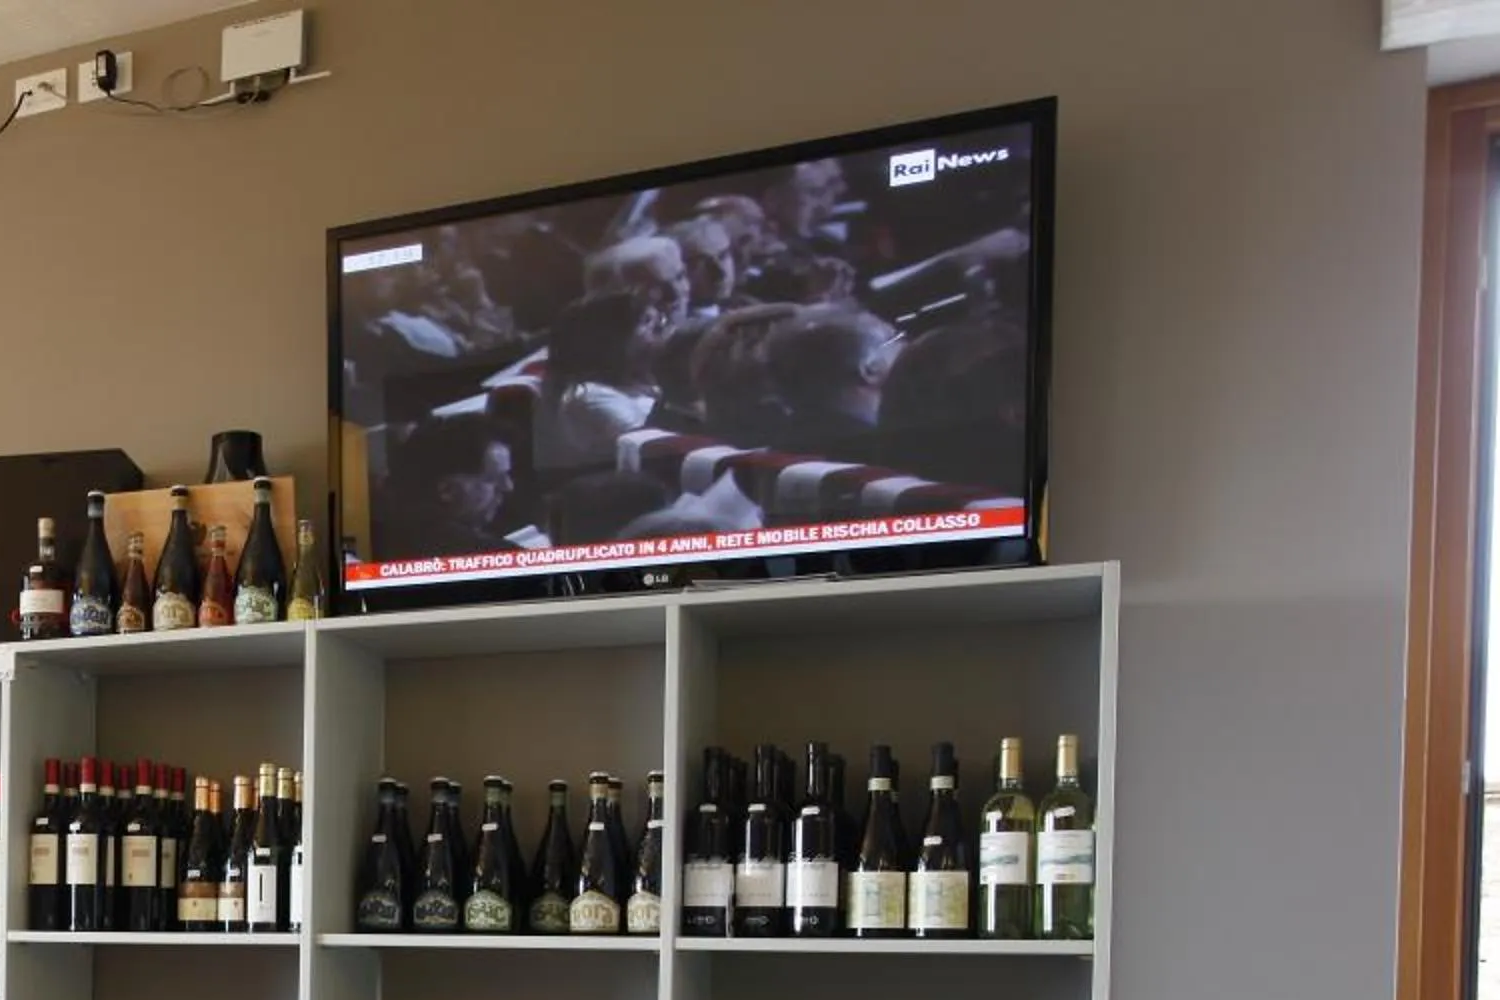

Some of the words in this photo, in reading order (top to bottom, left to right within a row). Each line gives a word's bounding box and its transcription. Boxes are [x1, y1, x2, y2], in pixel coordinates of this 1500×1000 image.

[893, 159, 931, 179] Rai
[937, 148, 1010, 171] News
[449, 553, 513, 572] TRAFFICO
[516, 544, 635, 567] QUADRUPLICATO
[638, 542, 655, 555] IN
[656, 540, 668, 553] 4
[669, 536, 711, 552] ANNI,
[715, 532, 754, 549] RETE
[757, 528, 819, 546] MOBILE
[821, 522, 889, 541] RISCHIA
[891, 512, 981, 534] COLLASSO
